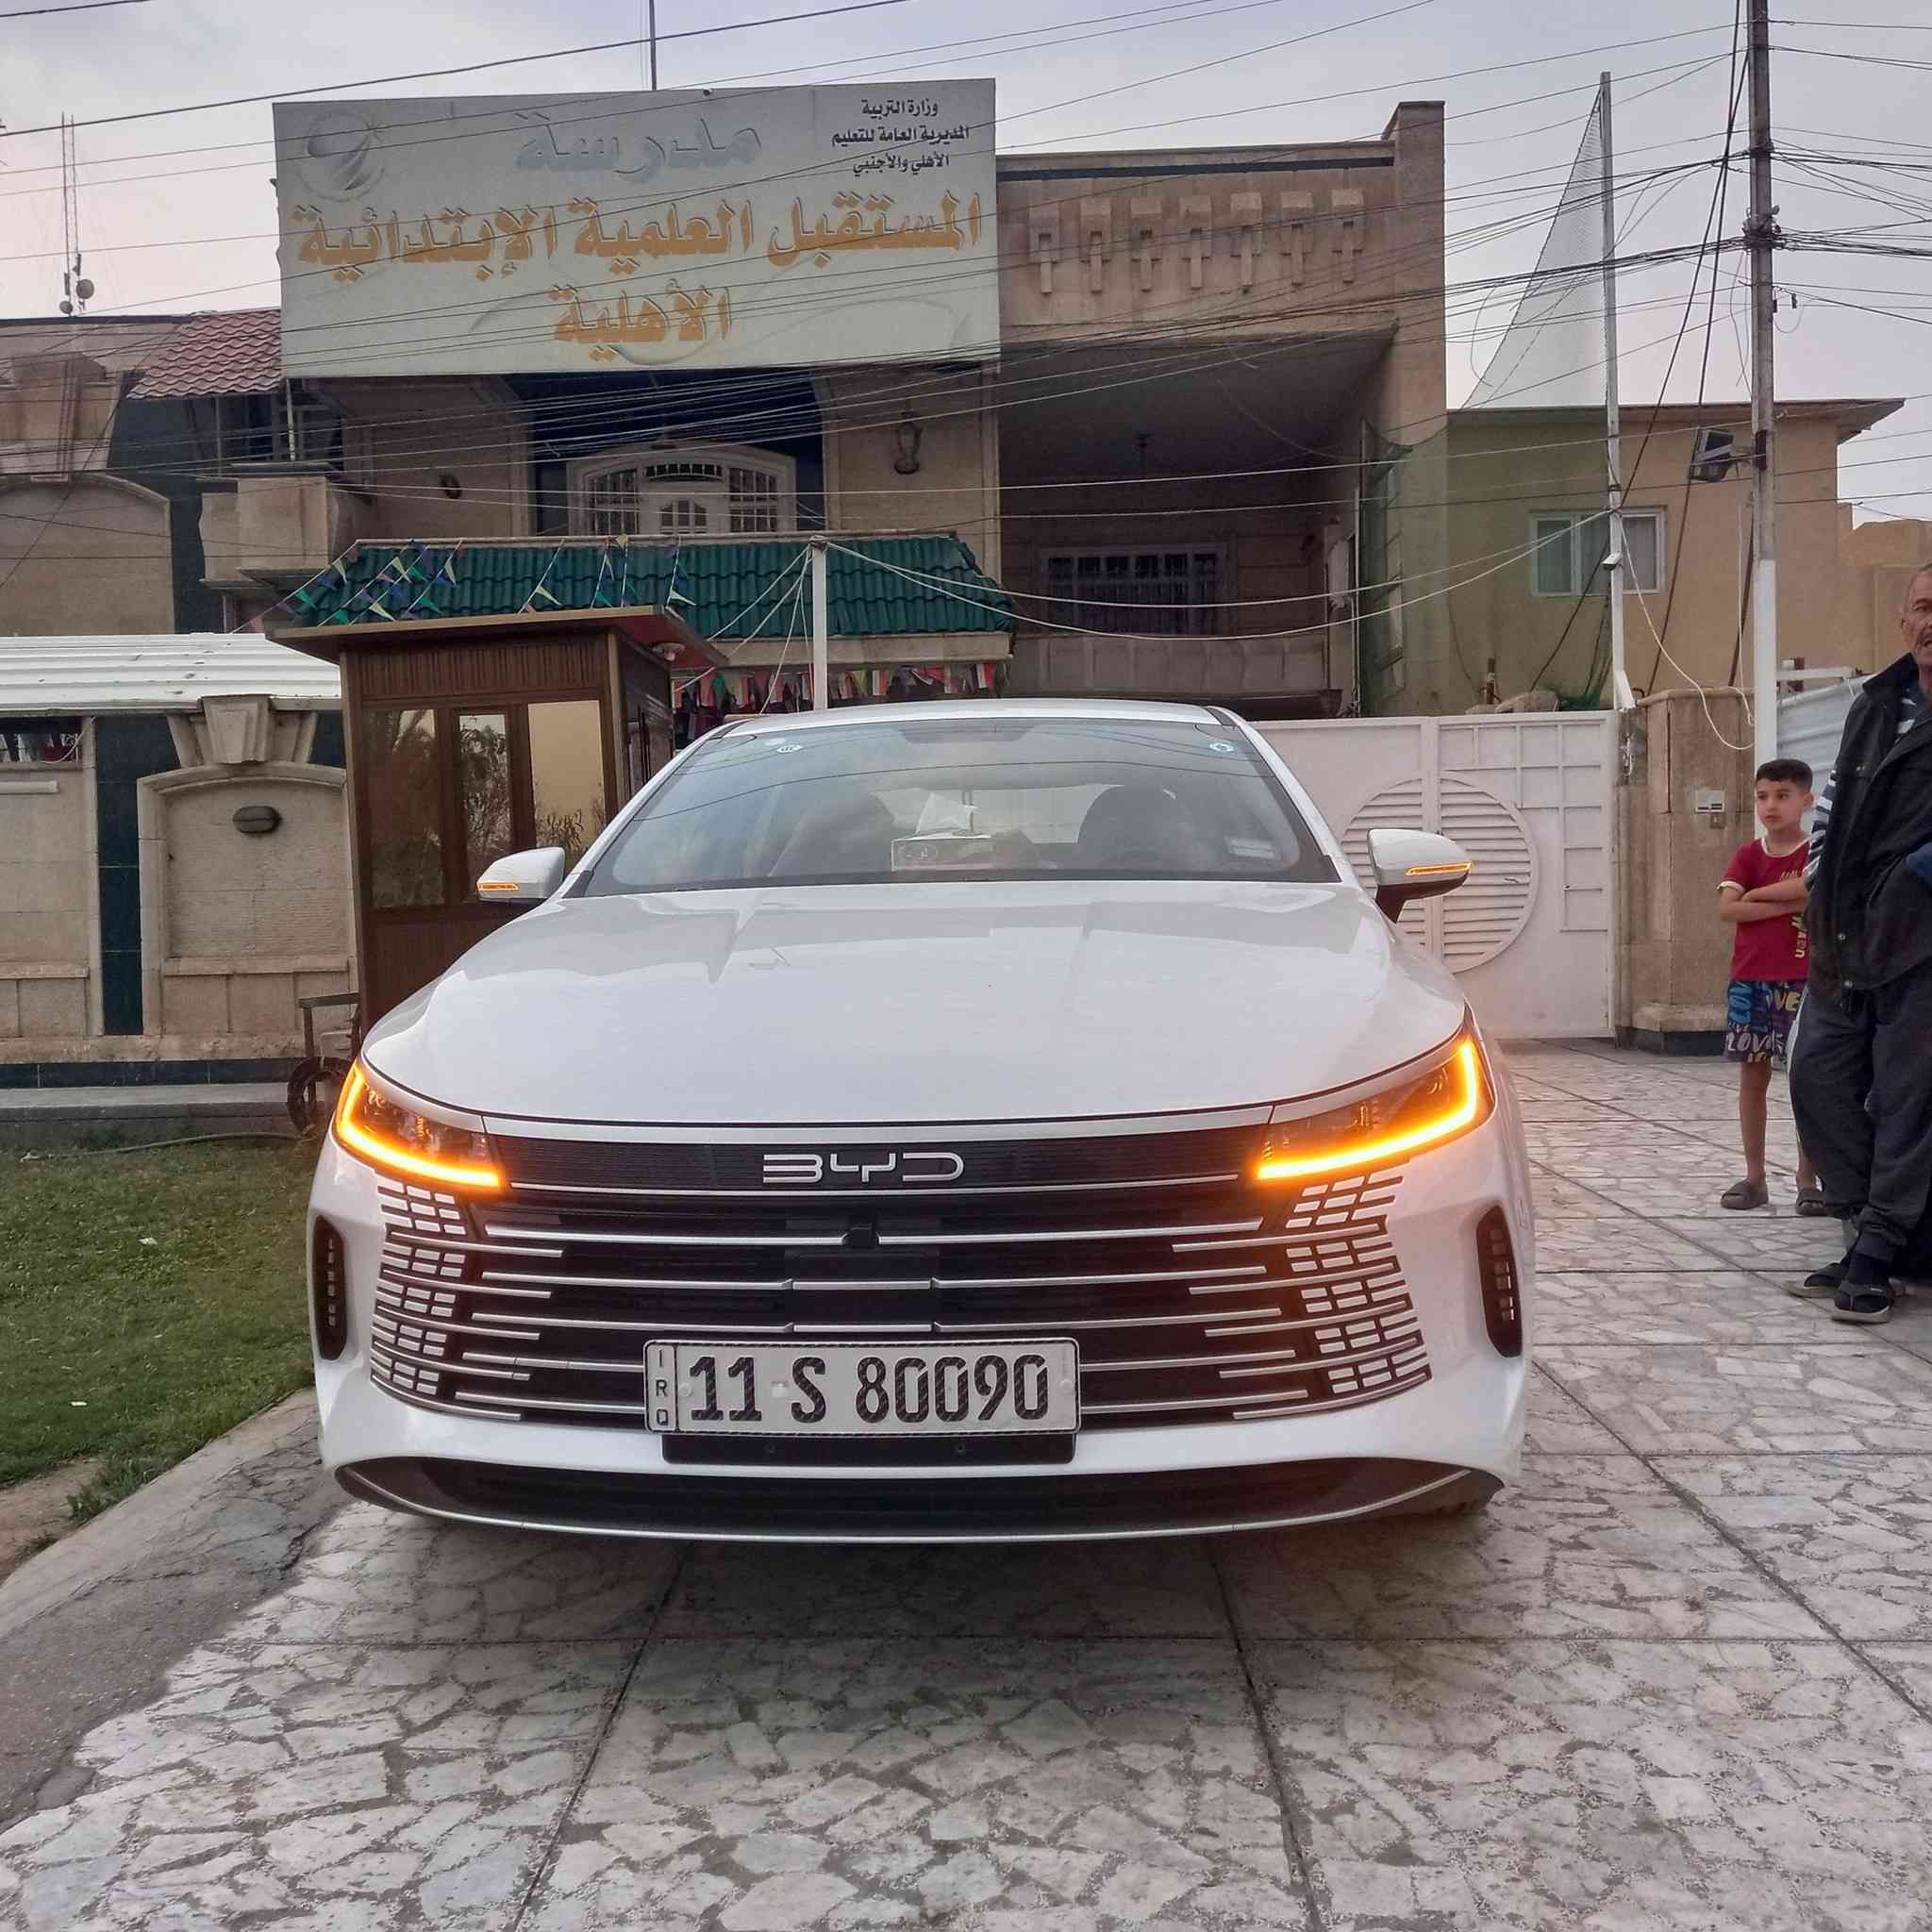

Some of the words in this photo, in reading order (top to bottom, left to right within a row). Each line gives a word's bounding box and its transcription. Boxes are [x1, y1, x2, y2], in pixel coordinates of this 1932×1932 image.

[860, 99, 906, 120] التربية
[907, 98, 939, 116] وزارة
[512, 111, 762, 182] مدرسة
[831, 128, 875, 147] للتعليم
[877, 125, 917, 142] العامة
[920, 125, 970, 145] المديرية
[853, 153, 908, 177] والأجنبي
[910, 151, 950, 175] الأهلي
[567, 196, 755, 275] العلمية
[767, 190, 981, 268] المستقبل
[553, 278, 732, 363] الأهلية
[762, 1152, 965, 1184] BYD
[656, 1349, 670, 1427] IRQ
[690, 1357, 762, 1422] 11
[791, 1357, 827, 1424] S
[856, 1354, 1049, 1424] 80090
